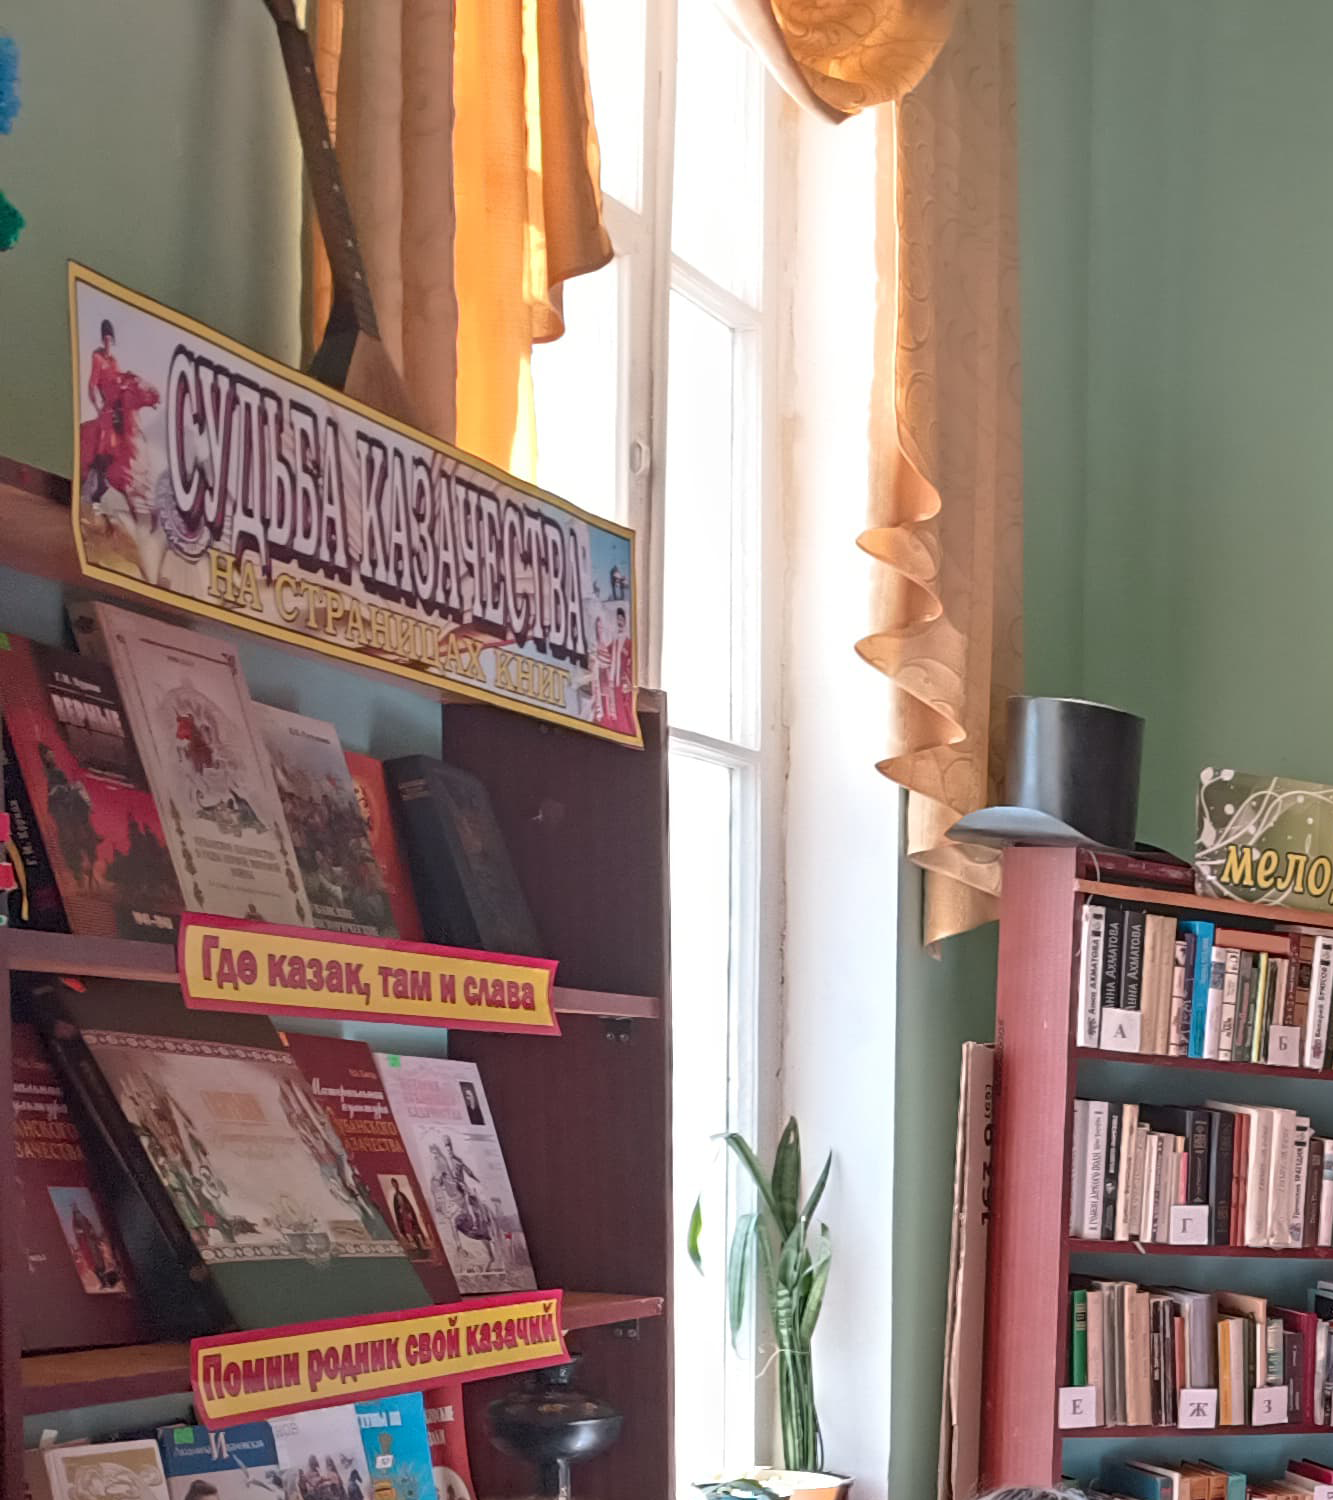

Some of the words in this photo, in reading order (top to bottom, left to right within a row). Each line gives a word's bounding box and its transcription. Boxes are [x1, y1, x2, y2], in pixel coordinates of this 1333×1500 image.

[166, 345, 350, 577] СУДЬБА
[355, 432, 590, 665] КАЗАЧЕСТВА
[208, 549, 264, 613] НА
[273, 576, 486, 684] СТРАНИЦАХ
[493, 644, 573, 708] КНИГ
[201, 934, 258, 993] Где
[268, 953, 372, 1005] казак,
[377, 966, 433, 1002] там
[440, 971, 457, 1004] и
[463, 975, 537, 1012] слава
[1106, 923, 1119, 979] АХМАТОВА
[1127, 924, 1141, 979] АХМАТОВА
[1181, 1218, 1193, 1233] Г
[201, 1352, 302, 1402] Помни
[307, 1334, 403, 1391] родник
[405, 1315, 460, 1368] свой
[464, 1302, 558, 1355] казачий
[1071, 1398, 1083, 1415] Е
[1189, 1403, 1208, 1417] Ж
